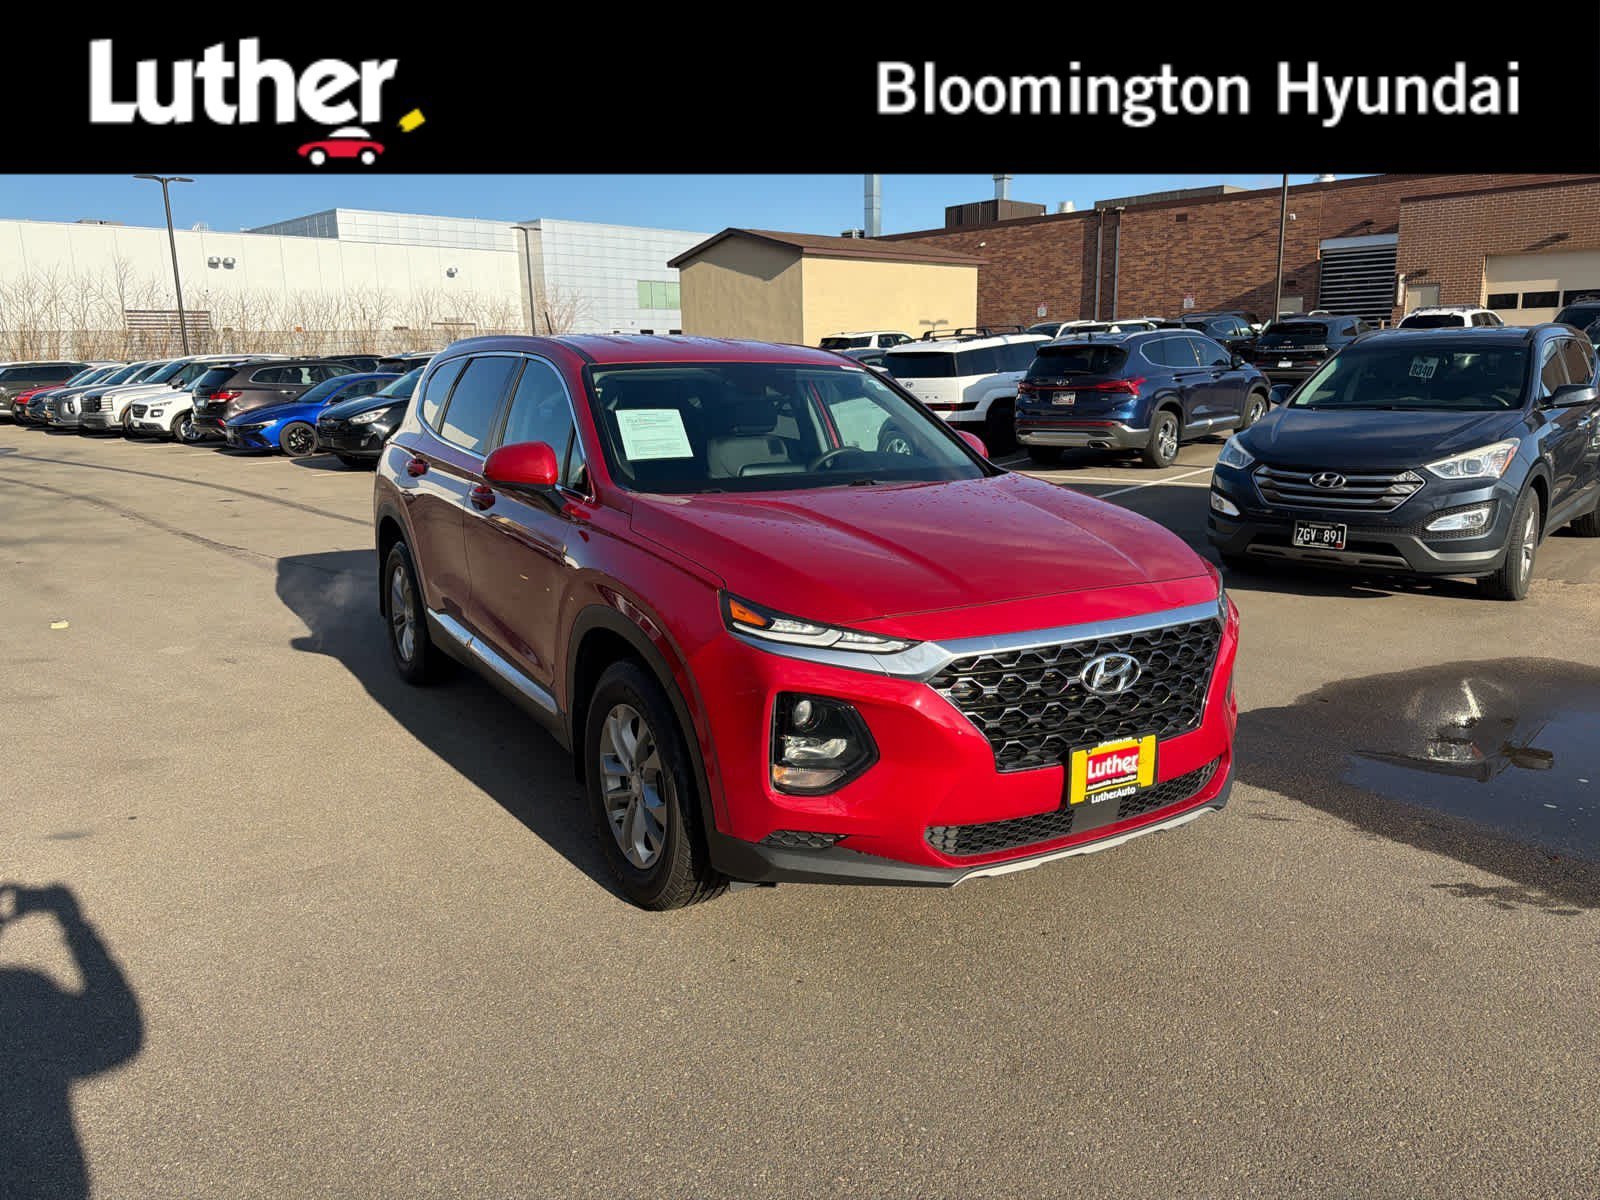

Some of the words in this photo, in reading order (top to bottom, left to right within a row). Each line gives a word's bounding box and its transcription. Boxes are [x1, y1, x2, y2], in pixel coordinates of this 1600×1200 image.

[1297, 527, 1317, 542] ZGV
[1323, 529, 1342, 544] 891
[1087, 754, 1139, 780] Luther
[1091, 786, 1137, 804] LutherAuto
